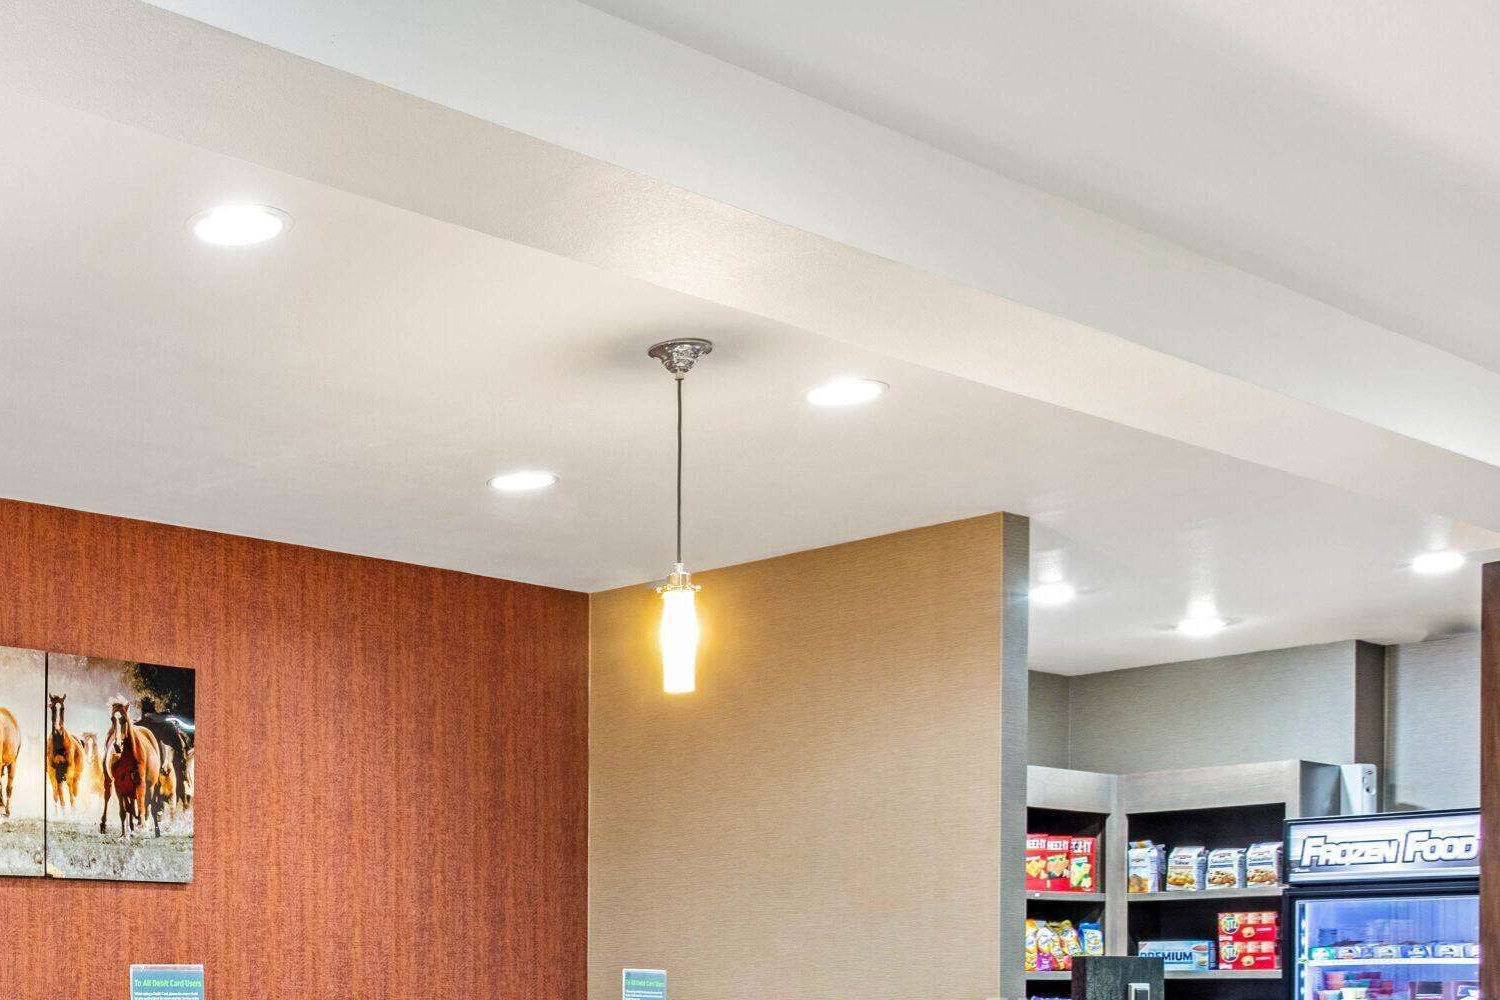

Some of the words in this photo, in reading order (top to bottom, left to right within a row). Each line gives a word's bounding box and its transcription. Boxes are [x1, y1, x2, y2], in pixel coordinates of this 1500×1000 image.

[1300, 835, 1400, 868] FROZEN
[1402, 829, 1480, 863] FOOD
[134, 979, 142, 987] To
[169, 979, 184, 987] Card
[185, 979, 202, 988] Users
